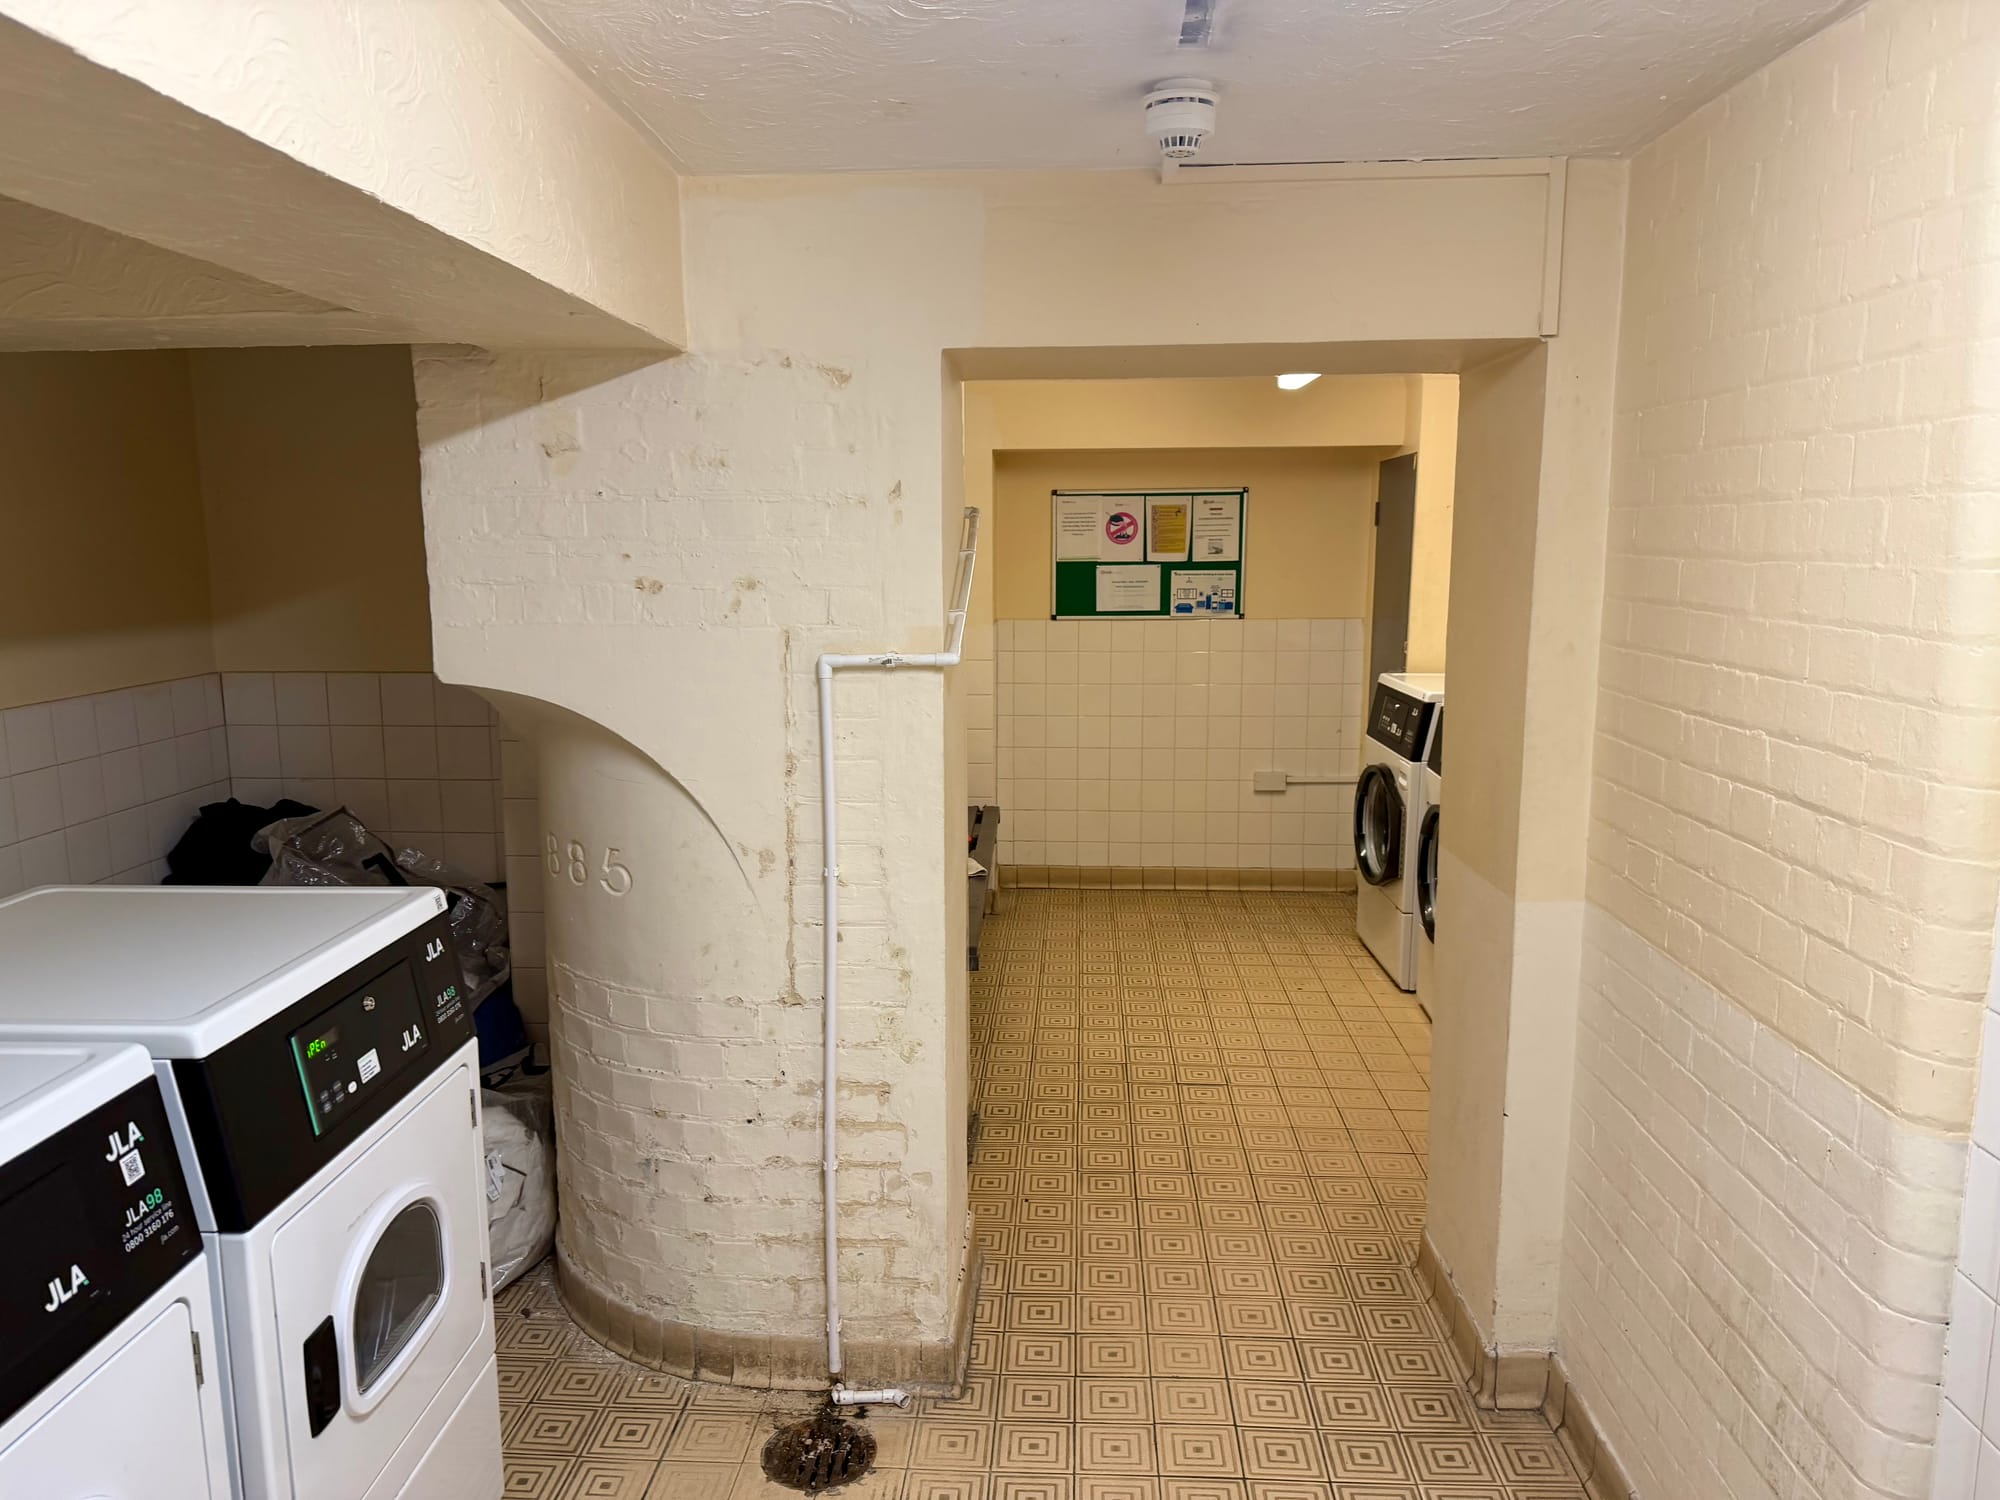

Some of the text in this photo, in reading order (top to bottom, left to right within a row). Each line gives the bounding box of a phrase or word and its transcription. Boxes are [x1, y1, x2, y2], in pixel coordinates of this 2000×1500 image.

[547, 832, 633, 897] 885
[125, 1187, 163, 1228] JLA98
[125, 1209, 175, 1253] 0800 3160 176
